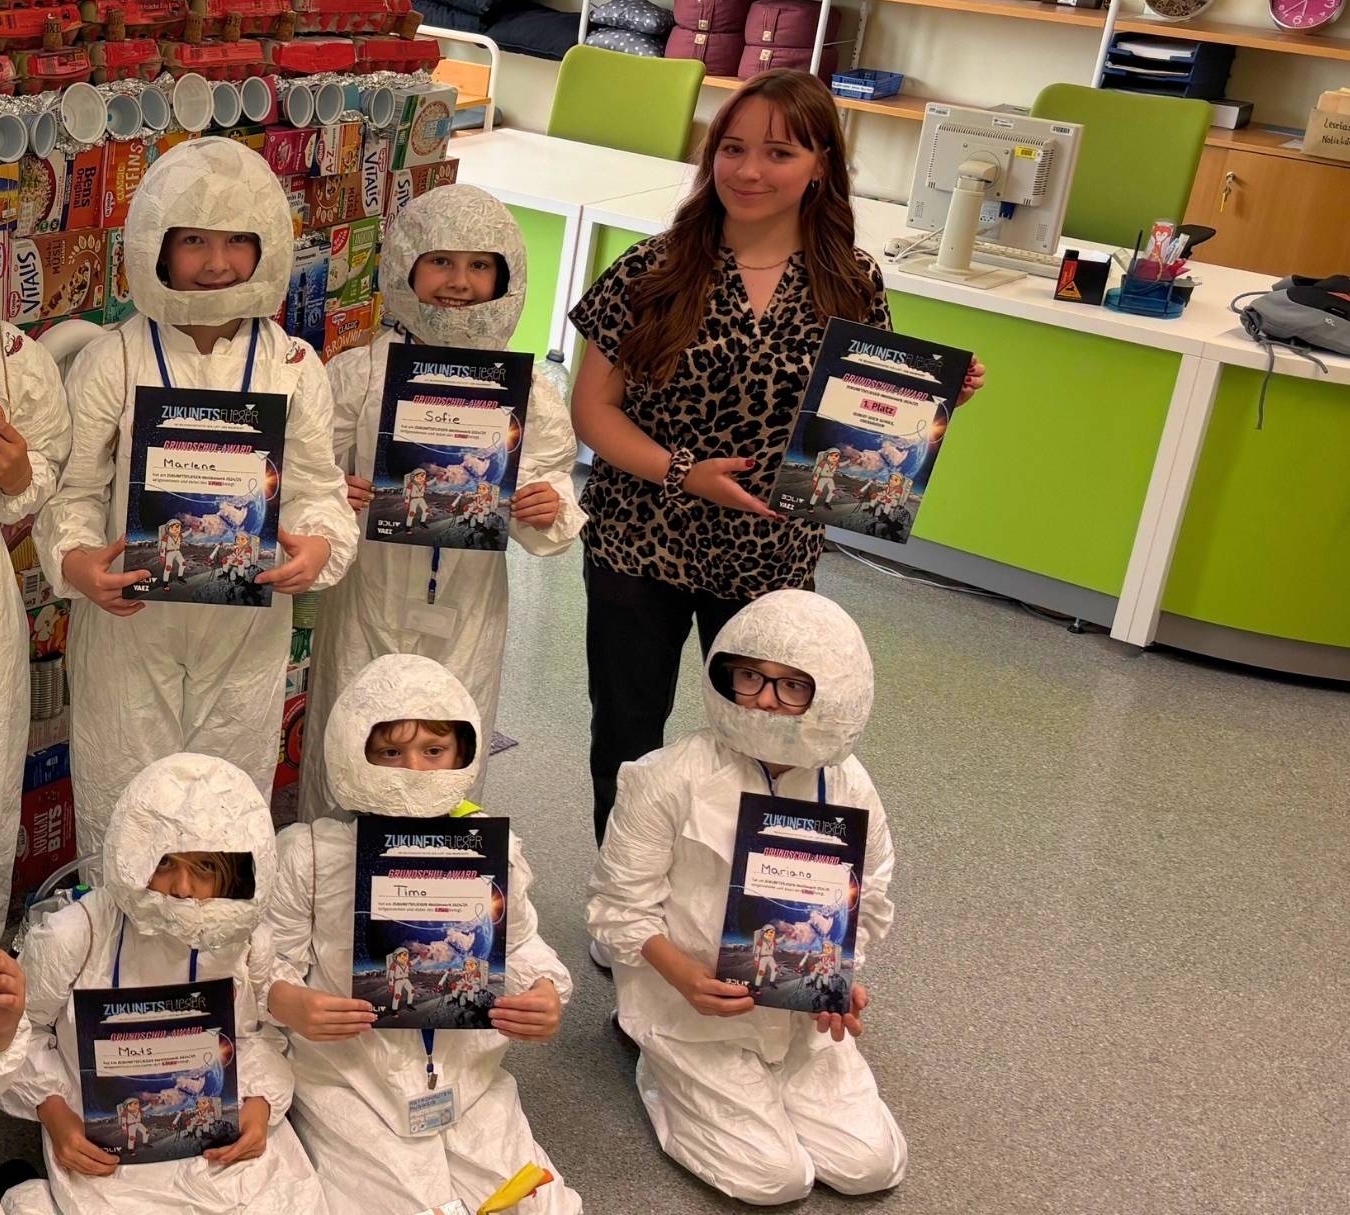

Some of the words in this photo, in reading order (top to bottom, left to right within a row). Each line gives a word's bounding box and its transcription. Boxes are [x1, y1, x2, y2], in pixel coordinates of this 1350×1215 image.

[1293, 15, 1302, 24] 6
[365, 151, 378, 207] VITALIS
[73, 167, 85, 208] Original
[17, 251, 40, 313] VITALIS
[843, 373, 928, 401] GRUNDSCHUL-AWARD
[413, 395, 499, 410] GRUNDSCHUL-AWARD
[871, 401, 895, 415] Platz
[424, 410, 460, 425] Sofie
[163, 439, 252, 455] GRUNDSCHUL-AWARD
[163, 458, 217, 472] Marlene
[33, 811, 48, 857] NOUGAT
[47, 804, 63, 852] BITS
[763, 847, 840, 865] GRUNDSCHUL-AWARD
[388, 869, 478, 880] GRUNDSCHUL-AWARD
[394, 885, 427, 897] Timo
[110, 1026, 203, 1042] GRUNDSCHUL-AWARD
[118, 1046, 152, 1057] Mats
